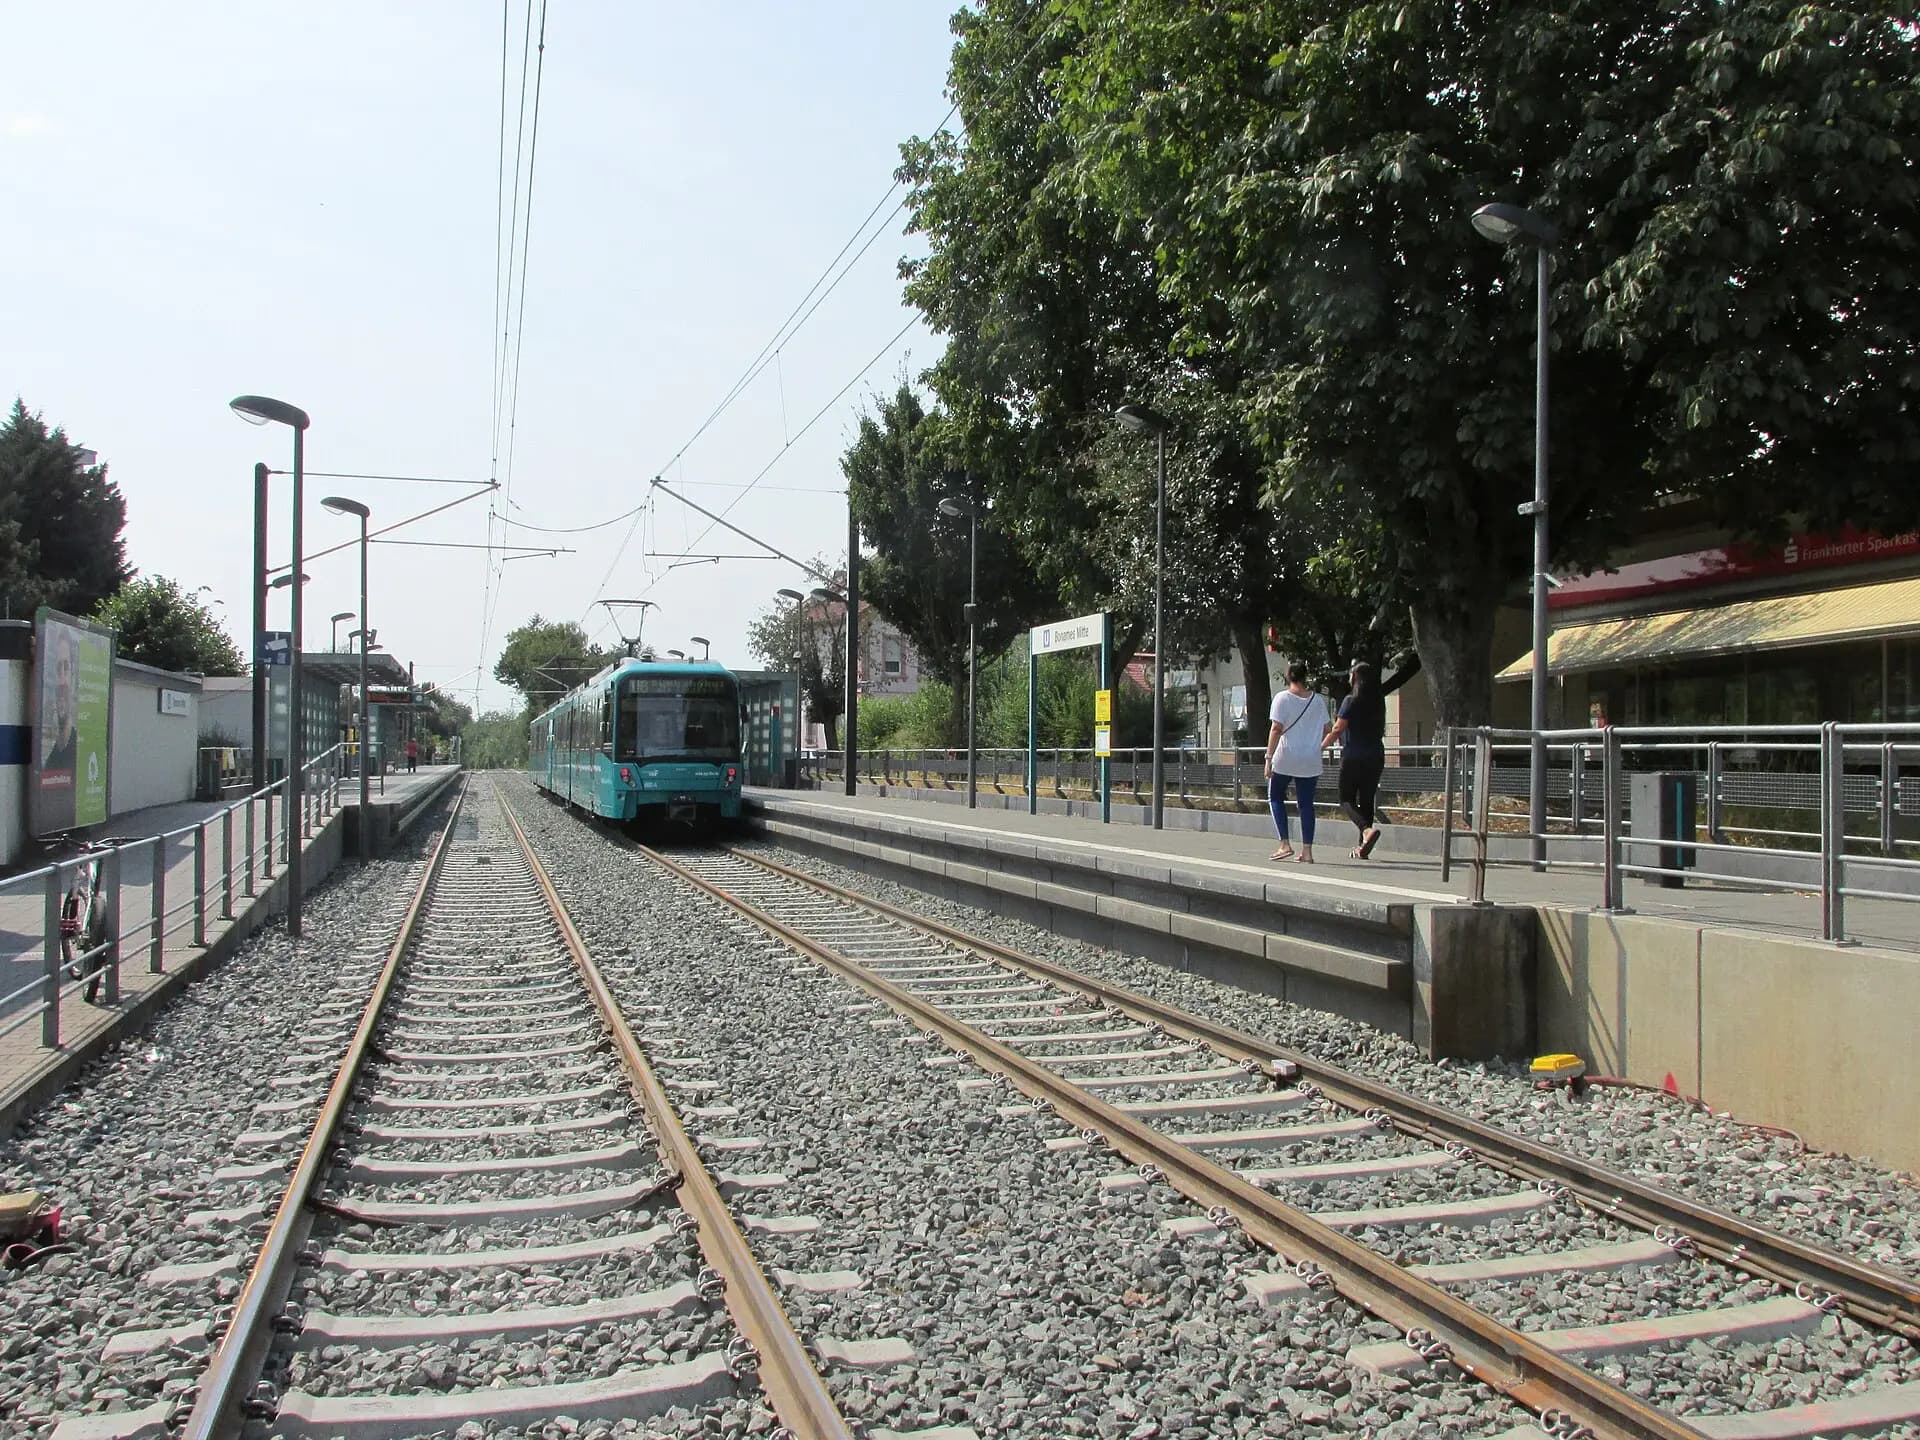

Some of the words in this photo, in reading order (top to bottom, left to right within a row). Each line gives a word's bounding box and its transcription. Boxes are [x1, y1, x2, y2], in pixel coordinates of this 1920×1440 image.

[1802, 541, 1865, 561] Frankfurter
[1867, 531, 1920, 553] Sparkas
[1054, 629, 1076, 643] Bonames
[1076, 625, 1089, 639] Mitte
